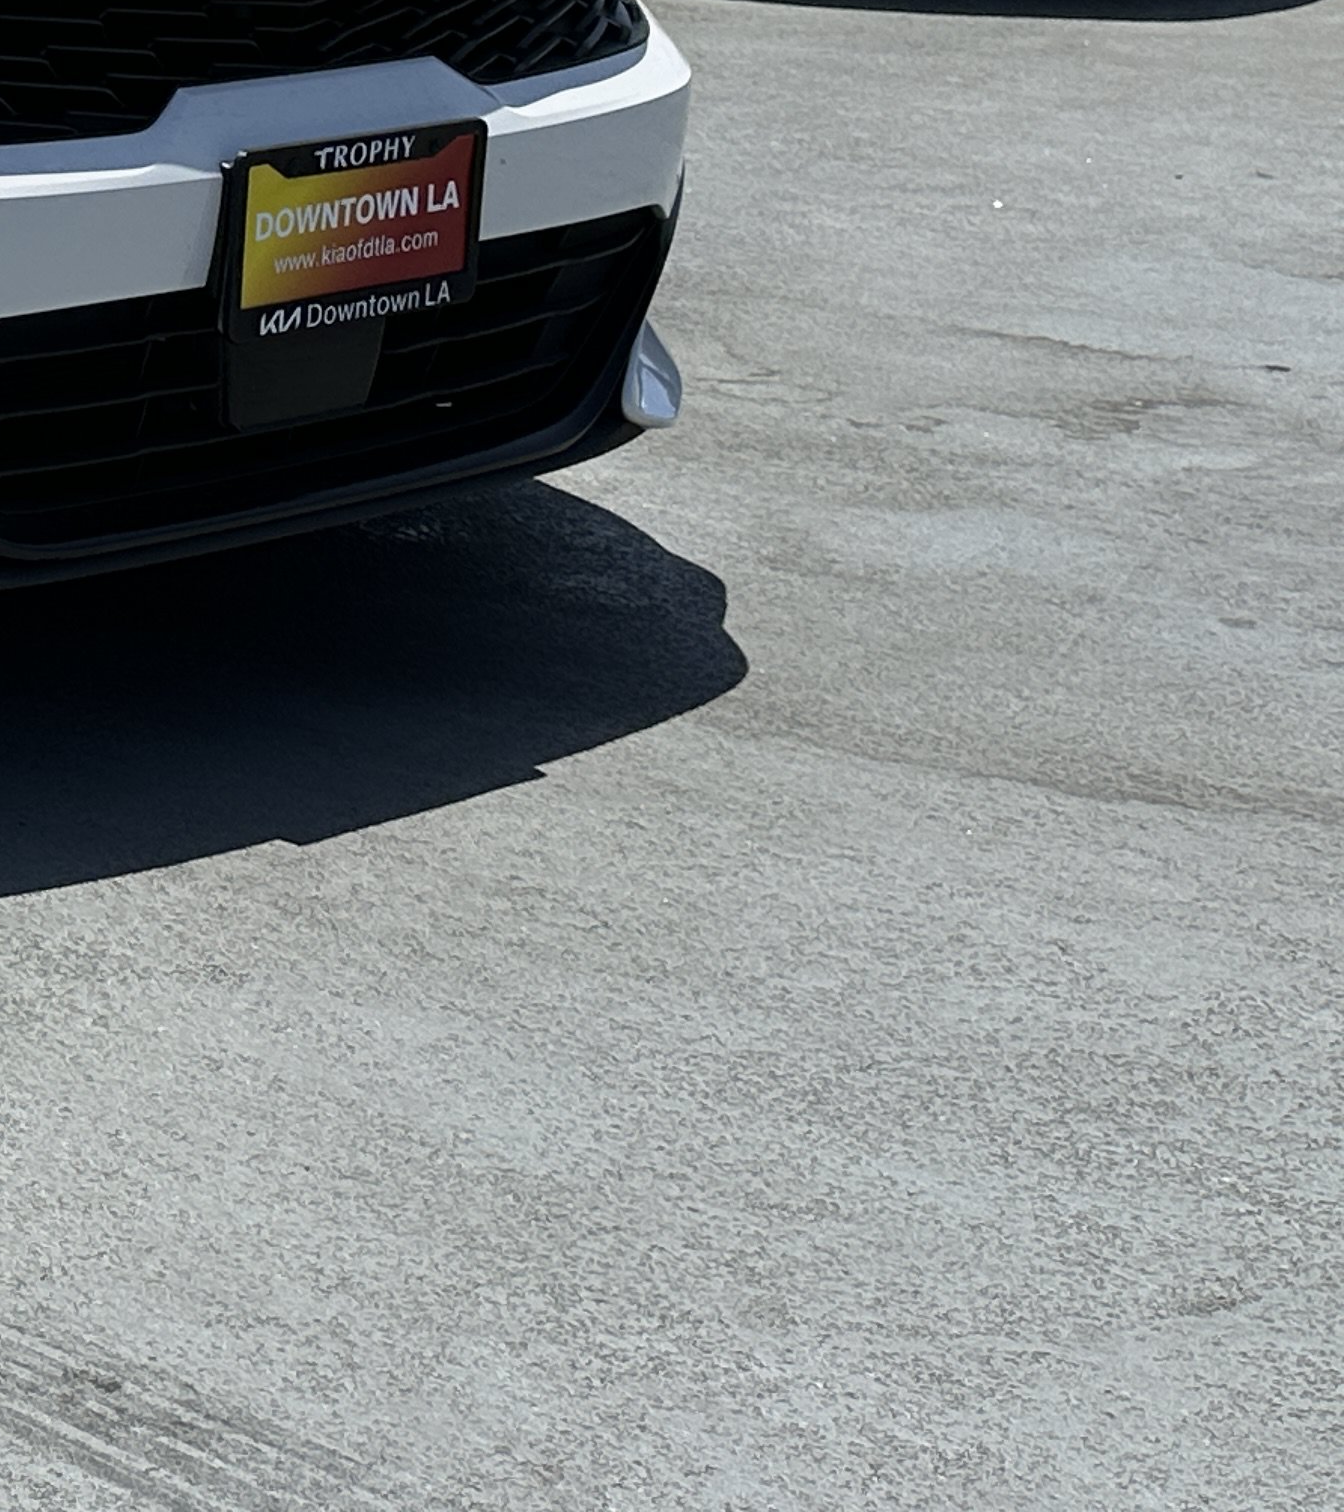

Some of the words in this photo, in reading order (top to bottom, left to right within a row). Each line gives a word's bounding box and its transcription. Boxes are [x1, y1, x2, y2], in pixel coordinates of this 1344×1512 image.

[314, 136, 416, 169] TROPHY
[255, 186, 419, 241] DOWNTOWN
[427, 180, 460, 213] LA
[274, 230, 438, 274] www.kiaofdtla.com
[259, 307, 302, 336] KIA
[306, 290, 420, 328] Downtown
[424, 280, 451, 307] LA
